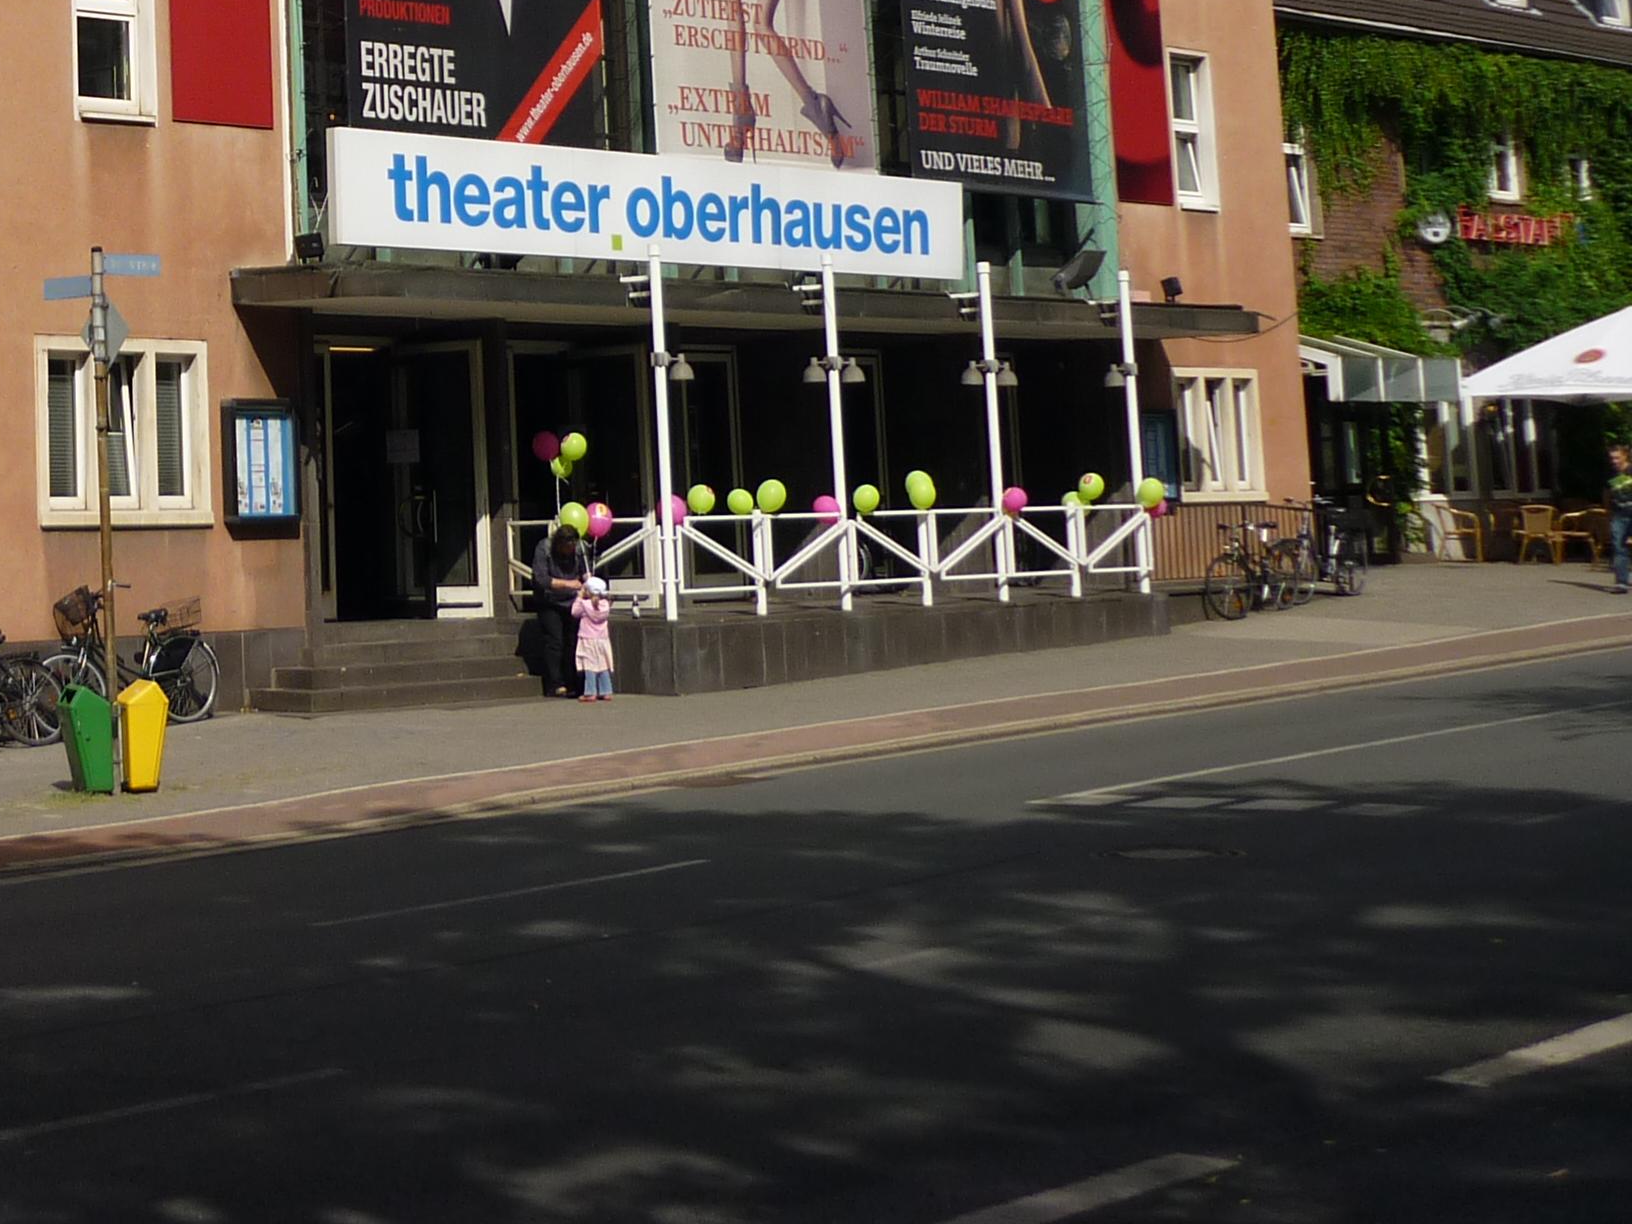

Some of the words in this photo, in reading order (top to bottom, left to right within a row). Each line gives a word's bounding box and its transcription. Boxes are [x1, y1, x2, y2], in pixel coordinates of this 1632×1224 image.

[360, 40, 456, 85] ERREGTE
[362, 83, 487, 128] ZUSCHAUER
[917, 88, 980, 113] WILLIAM
[919, 111, 946, 132] DER
[949, 117, 998, 138] STURM
[921, 150, 955, 171] UND
[956, 153, 1002, 175] VIELES
